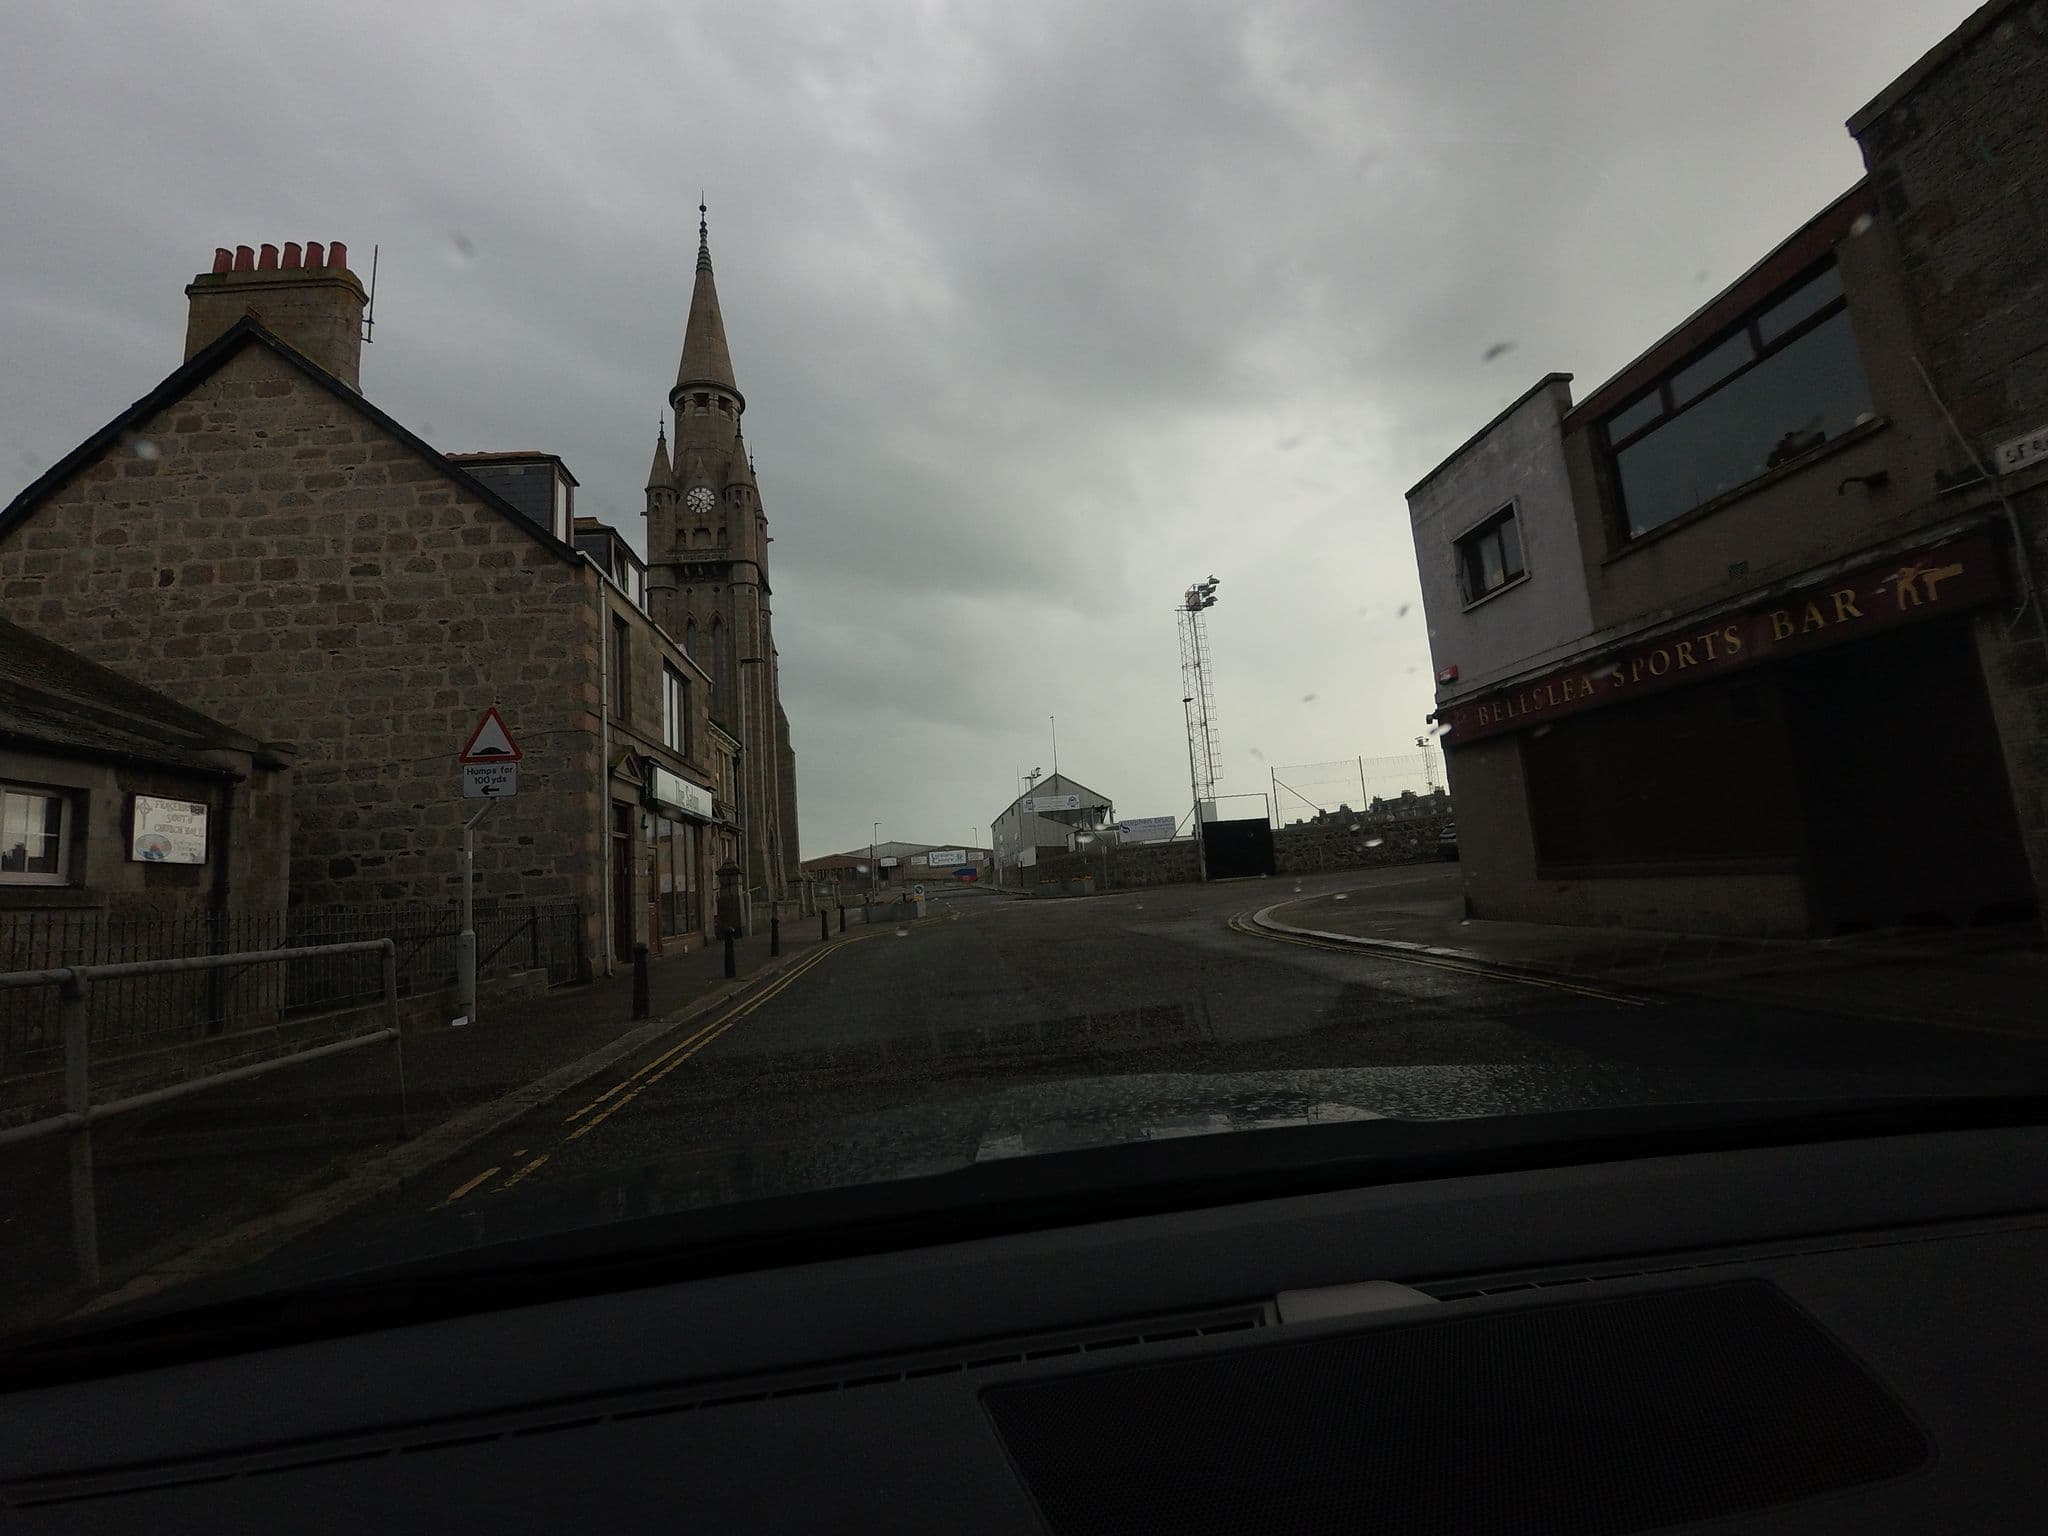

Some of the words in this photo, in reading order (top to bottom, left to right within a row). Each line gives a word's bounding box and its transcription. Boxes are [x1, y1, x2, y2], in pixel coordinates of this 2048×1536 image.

[1477, 674, 1595, 726] BELLSLEA
[1609, 624, 1742, 689] SPORTS
[1769, 587, 1865, 642] BAR
[474, 776, 490, 784] 100
[491, 775, 506, 784] yds
